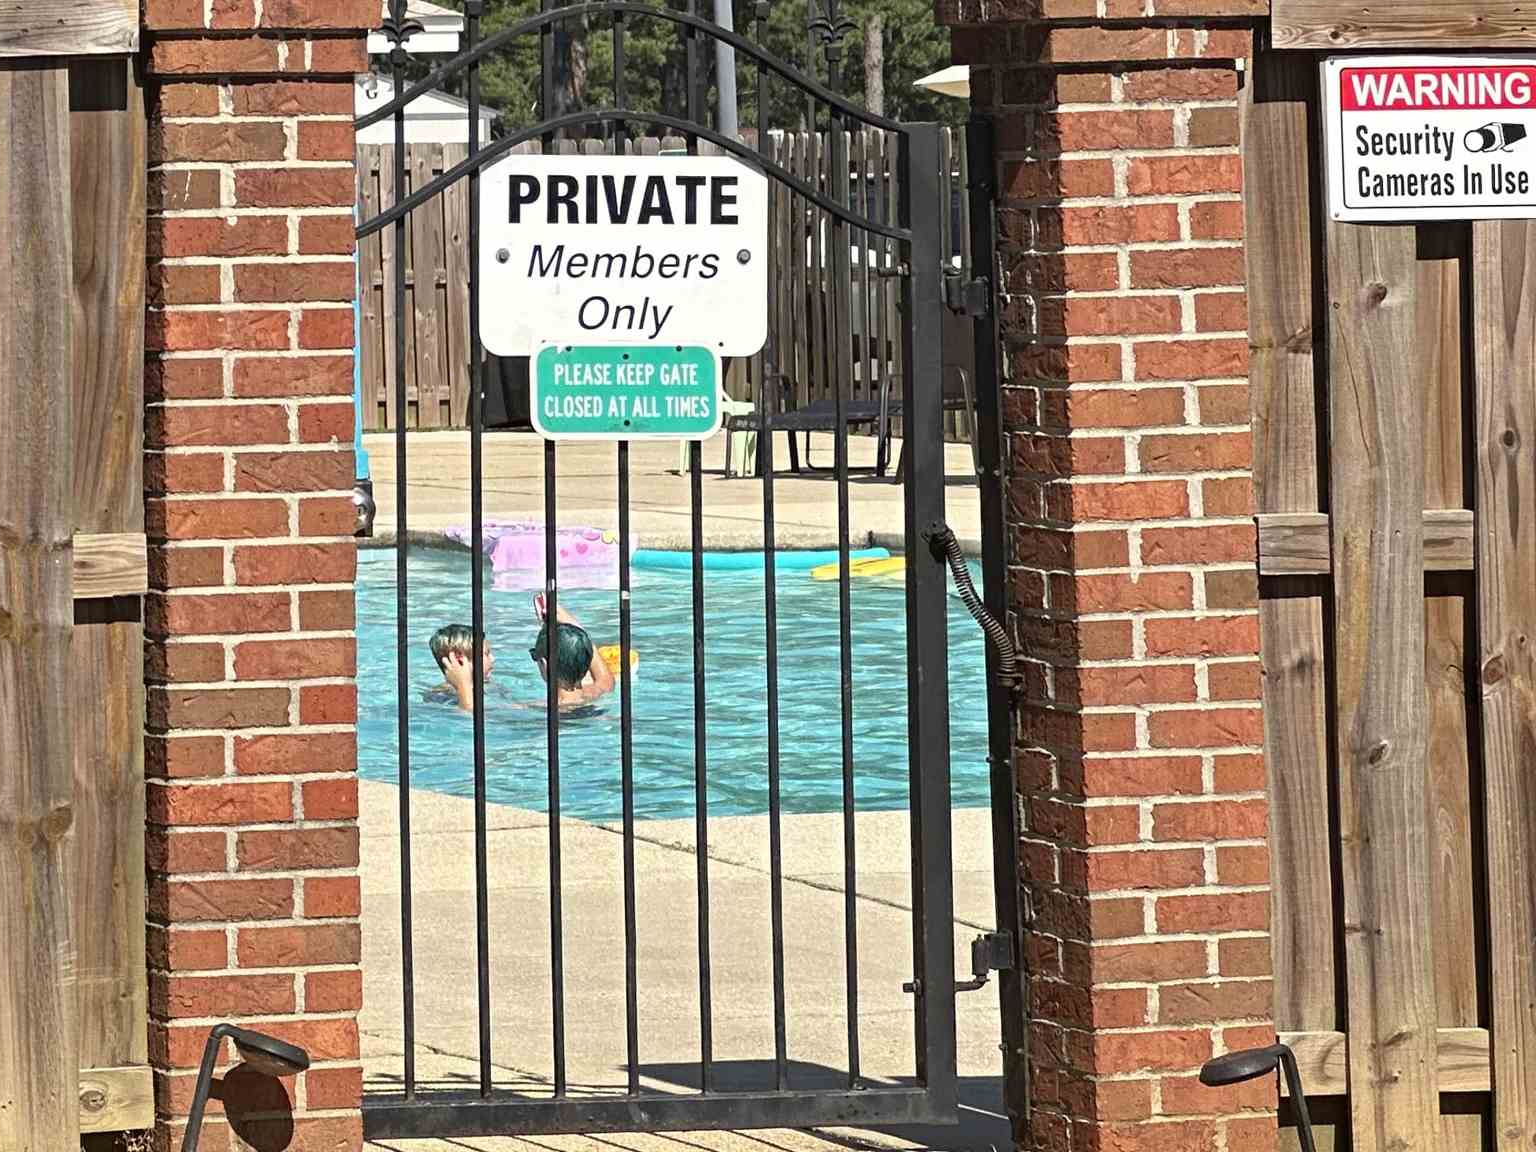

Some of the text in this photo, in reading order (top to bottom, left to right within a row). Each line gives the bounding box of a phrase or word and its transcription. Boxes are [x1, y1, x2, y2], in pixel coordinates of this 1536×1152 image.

[1351, 71, 1531, 106] WARNING
[1356, 124, 1455, 161] Security
[1358, 163, 1529, 198] Cameras In Use
[508, 174, 739, 225] PRIVATE
[527, 244, 720, 279] Members
[578, 295, 673, 340] Only
[553, 363, 698, 386] PLEASE KEEP GATE
[544, 395, 710, 418] CLOSED AT ALL TIMES
